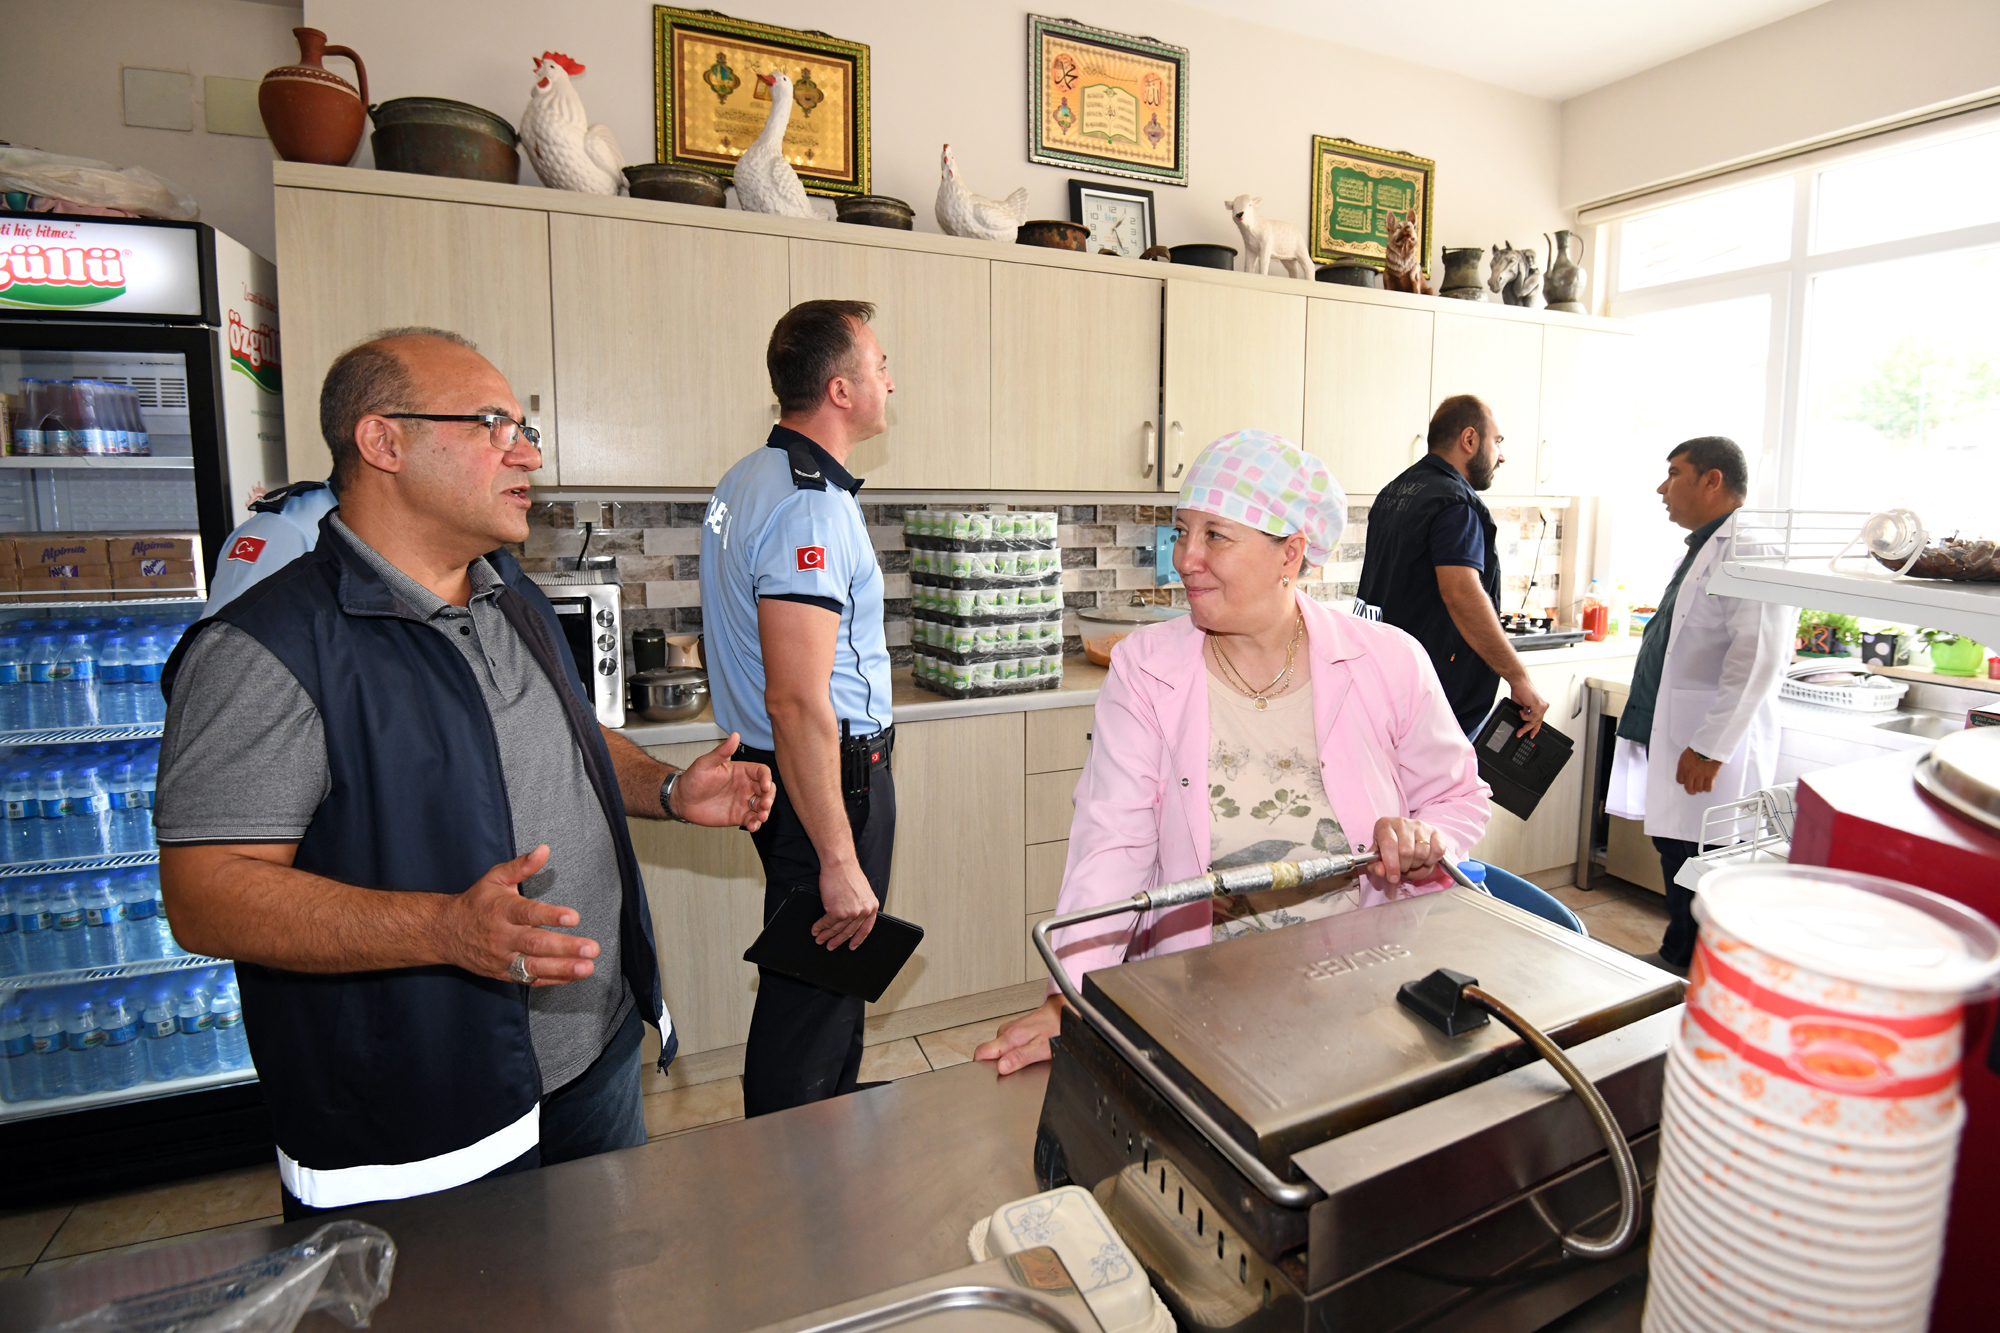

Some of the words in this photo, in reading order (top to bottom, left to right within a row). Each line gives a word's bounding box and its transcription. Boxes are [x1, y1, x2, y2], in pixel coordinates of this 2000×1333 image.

[1108, 206, 1117, 214] 12
[1090, 212, 1099, 220] 10
[1130, 217, 1137, 225] 2
[1090, 223, 1097, 231] 9
[13, 223, 33, 240] hiç
[1130, 228, 1137, 236] 3
[1090, 234, 1097, 242] 8
[131, 541, 175, 556] Alpimilk
[41, 547, 87, 563] Alpimilk
[1301, 944, 1411, 980] SILVER
